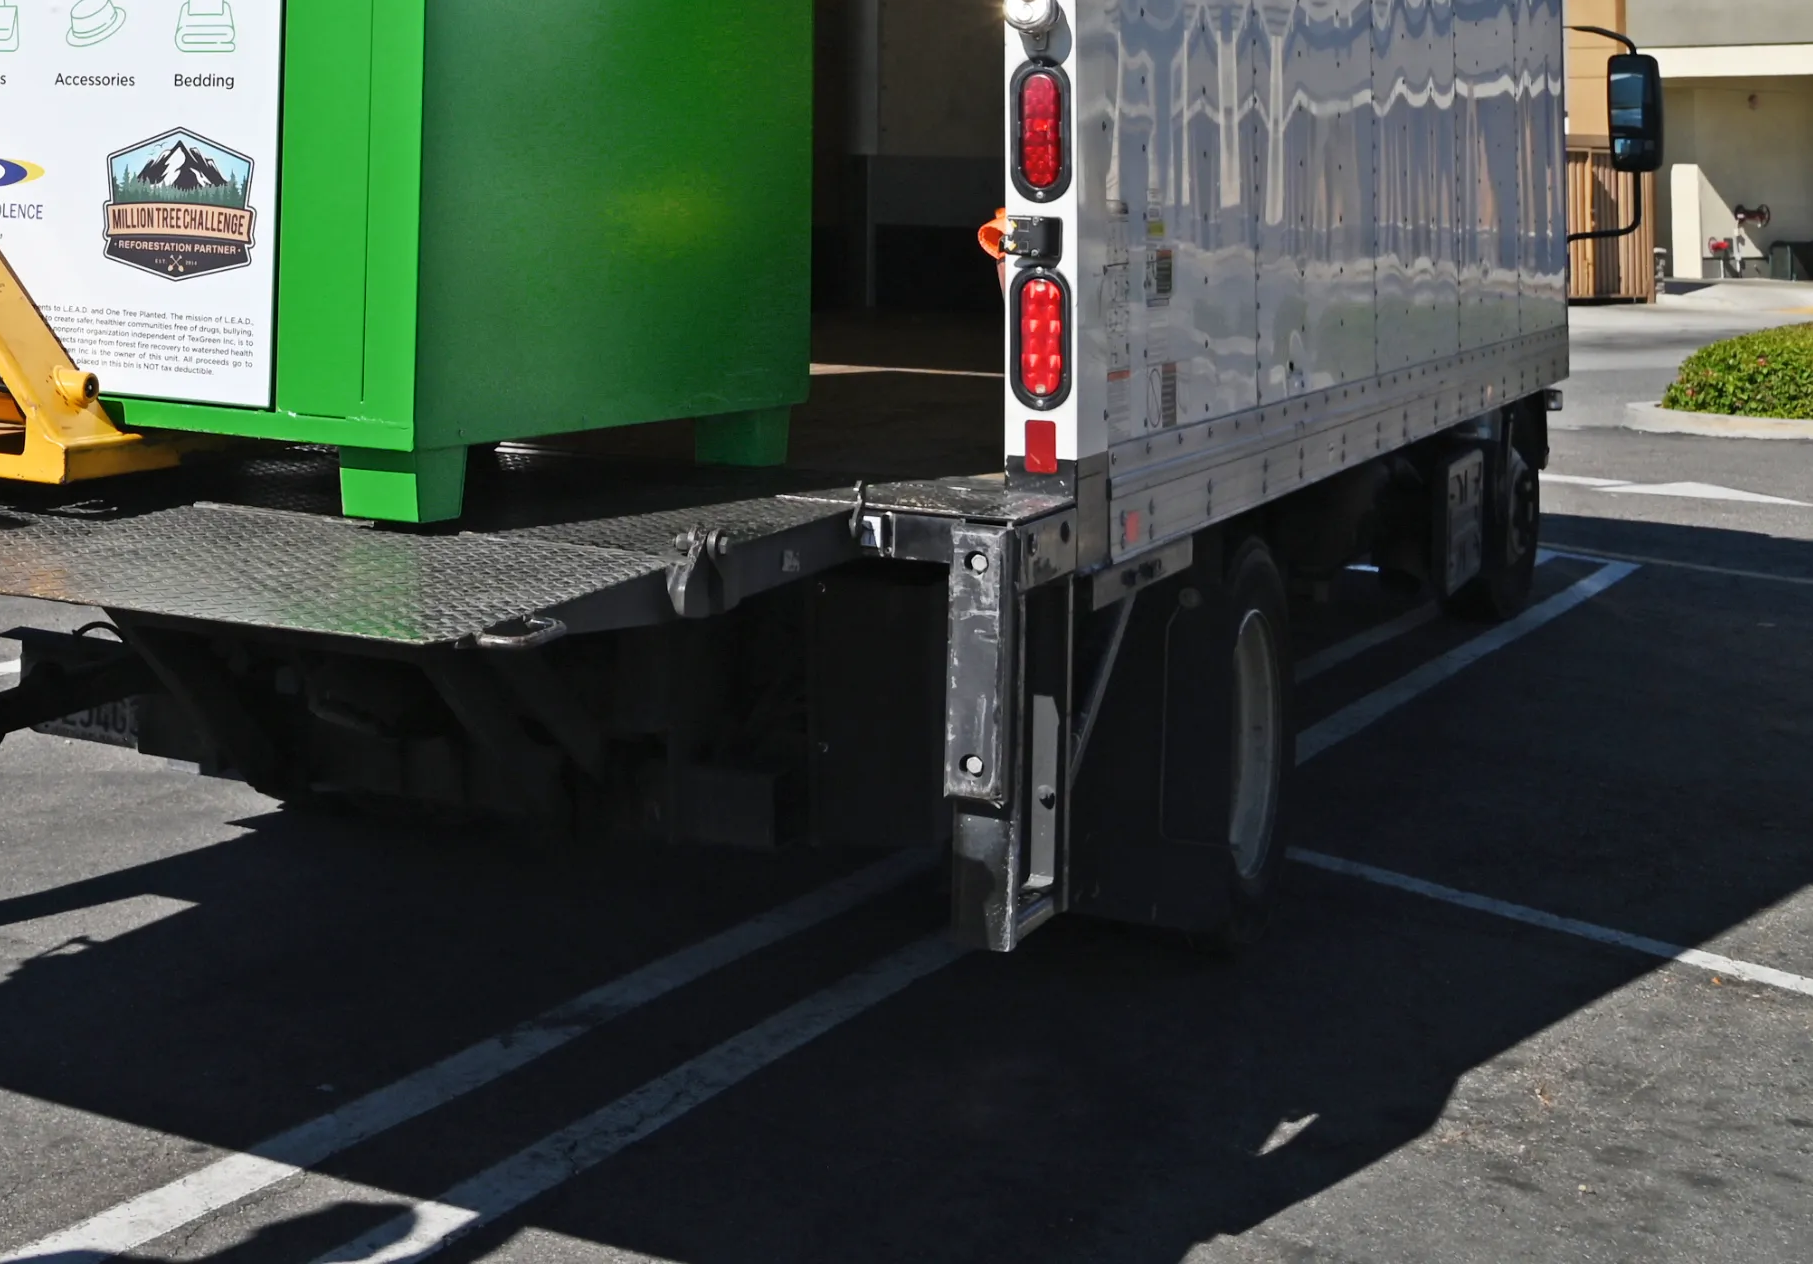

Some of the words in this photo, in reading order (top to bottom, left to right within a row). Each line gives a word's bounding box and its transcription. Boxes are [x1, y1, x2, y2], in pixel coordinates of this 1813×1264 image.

[54, 72, 135, 87] Accessories
[174, 73, 235, 90] Bedding
[112, 208, 154, 229] MILLION
[156, 206, 182, 229] TREE
[183, 207, 245, 236] CHALLENGE
[119, 240, 192, 252] REFORESTATION
[194, 243, 236, 255] PARTNER
[96, 318, 126, 326] healthier
[128, 322, 172, 330] communities
[186, 314, 212, 322] mission
[54, 326, 84, 334] nonprofit
[86, 328, 129, 337] organization
[131, 330, 175, 340] independent
[188, 335, 221, 344] TexGreen
[77, 338, 96, 346] range
[116, 339, 136, 348] forest
[151, 344, 180, 353] recovery
[192, 346, 229, 355] watershed
[231, 349, 253, 357] health
[77, 357, 99, 365] placed
[196, 358, 230, 366] proceeds
